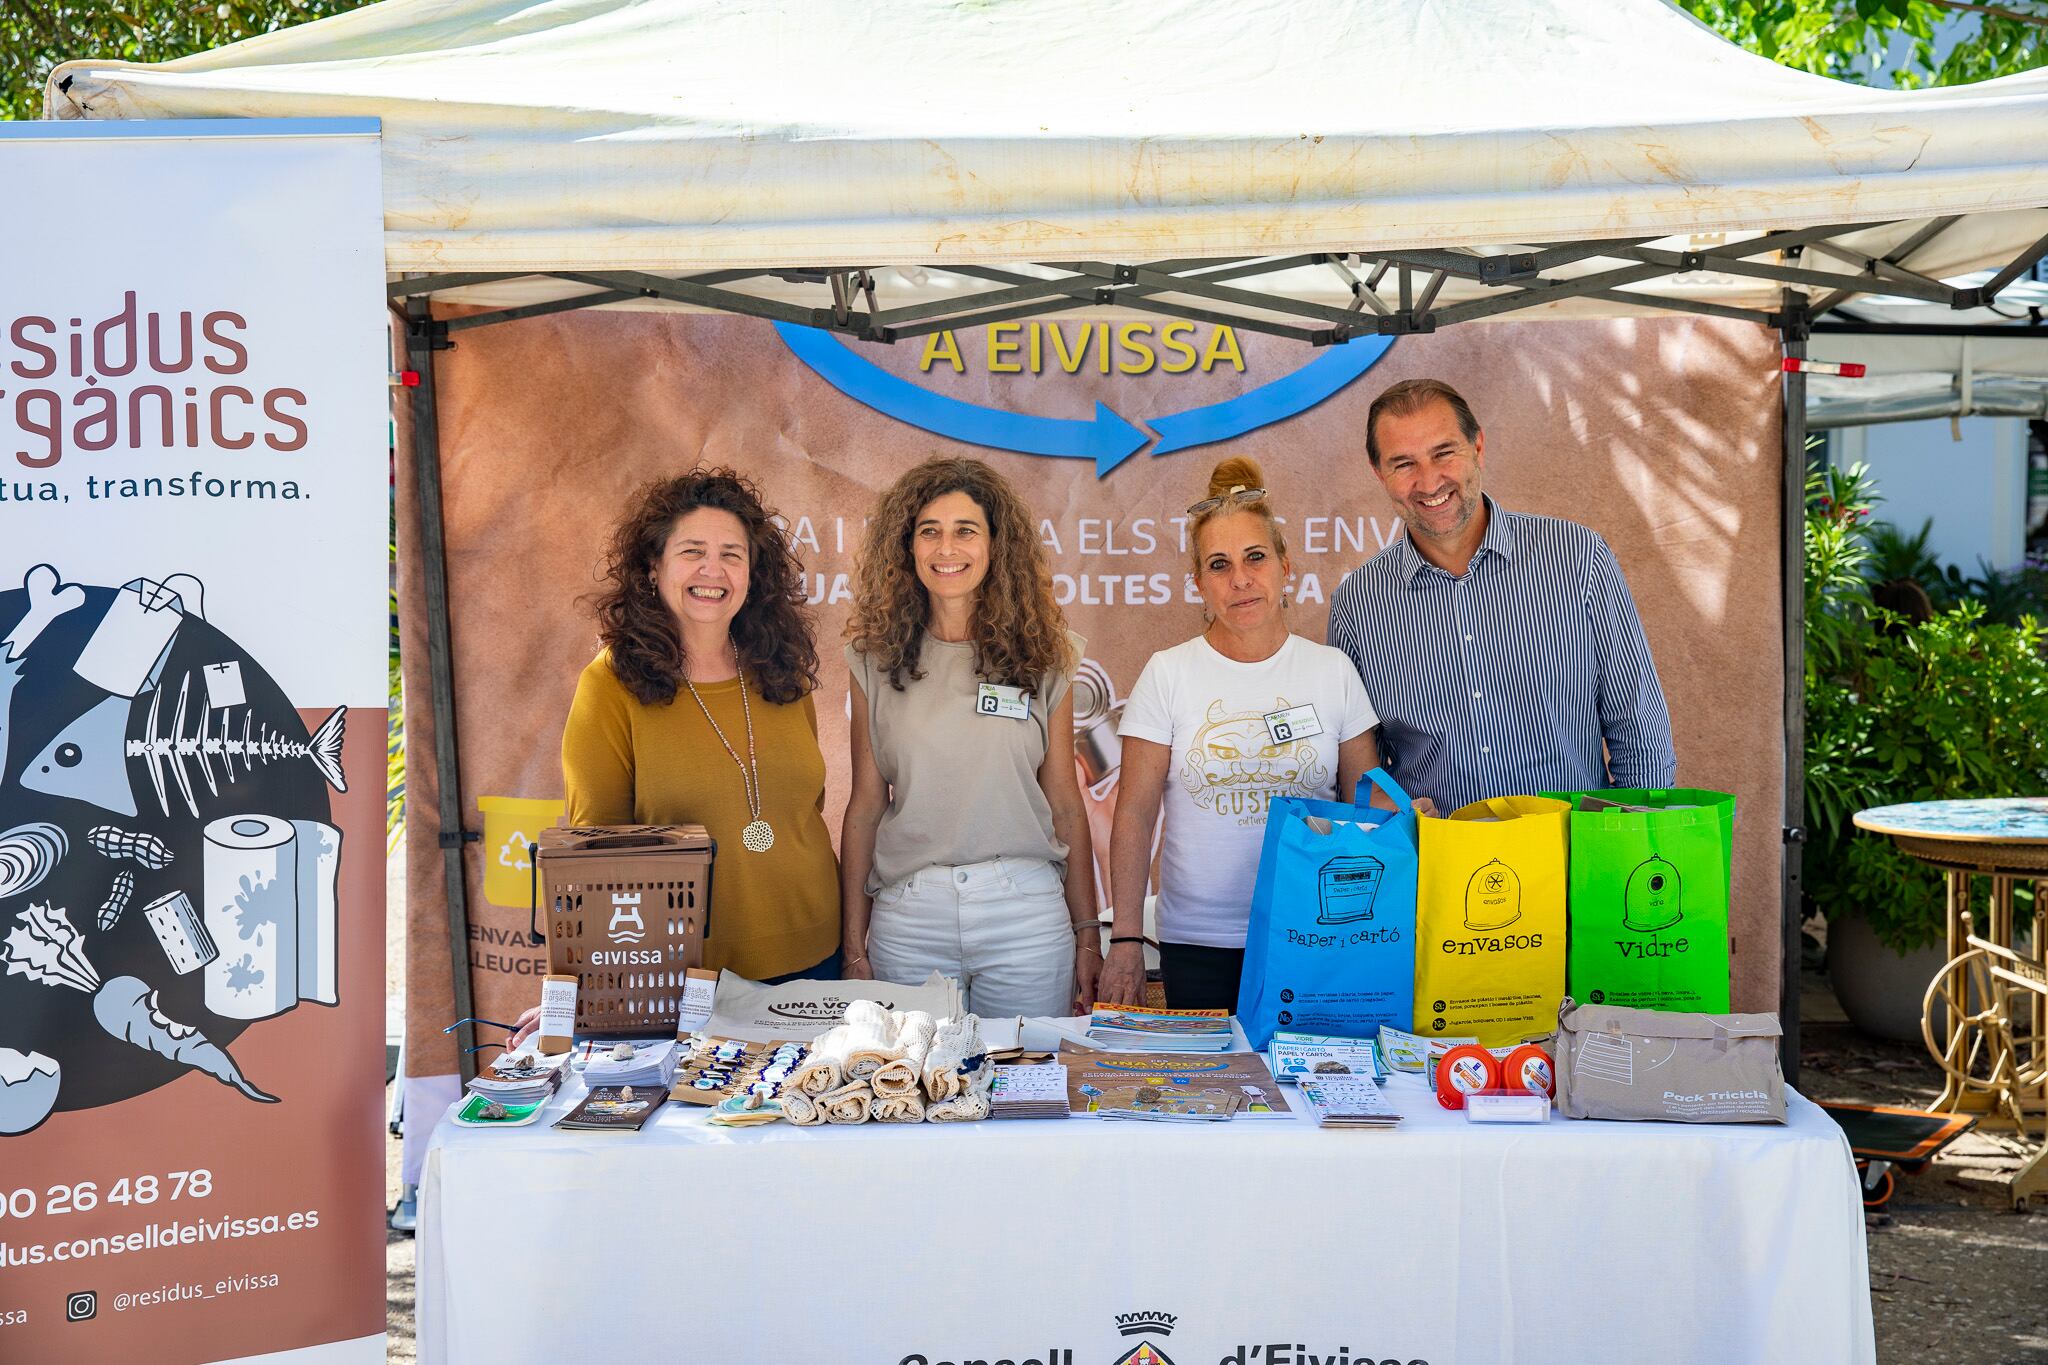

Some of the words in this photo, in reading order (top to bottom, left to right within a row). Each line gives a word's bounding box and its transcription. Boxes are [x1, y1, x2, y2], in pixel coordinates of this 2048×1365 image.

[0, 291, 248, 379] sidus
[919, 329, 964, 372] A
[987, 321, 1246, 373] EIVISSA
[0, 375, 308, 468] gànics
[87, 471, 311, 500] transforma.
[1079, 517, 1157, 555] ELS
[1052, 573, 1171, 606] OLTES
[1350, 926, 1400, 944] cartó
[1442, 933, 1543, 955] envasos
[1614, 933, 1690, 959] vidre
[469, 951, 548, 976] LEUGE
[591, 949, 663, 966] eivissa
[776, 1001, 818, 1010] UNA
[1663, 1091, 1705, 1103] Pack
[1707, 1090, 1769, 1101] Tricicla
[0, 1187, 37, 1219] 0
[46, 1181, 98, 1215] 26
[107, 1175, 160, 1206] 48
[167, 1169, 213, 1200] 78
[113, 1271, 280, 1312] @residus_eivissa
